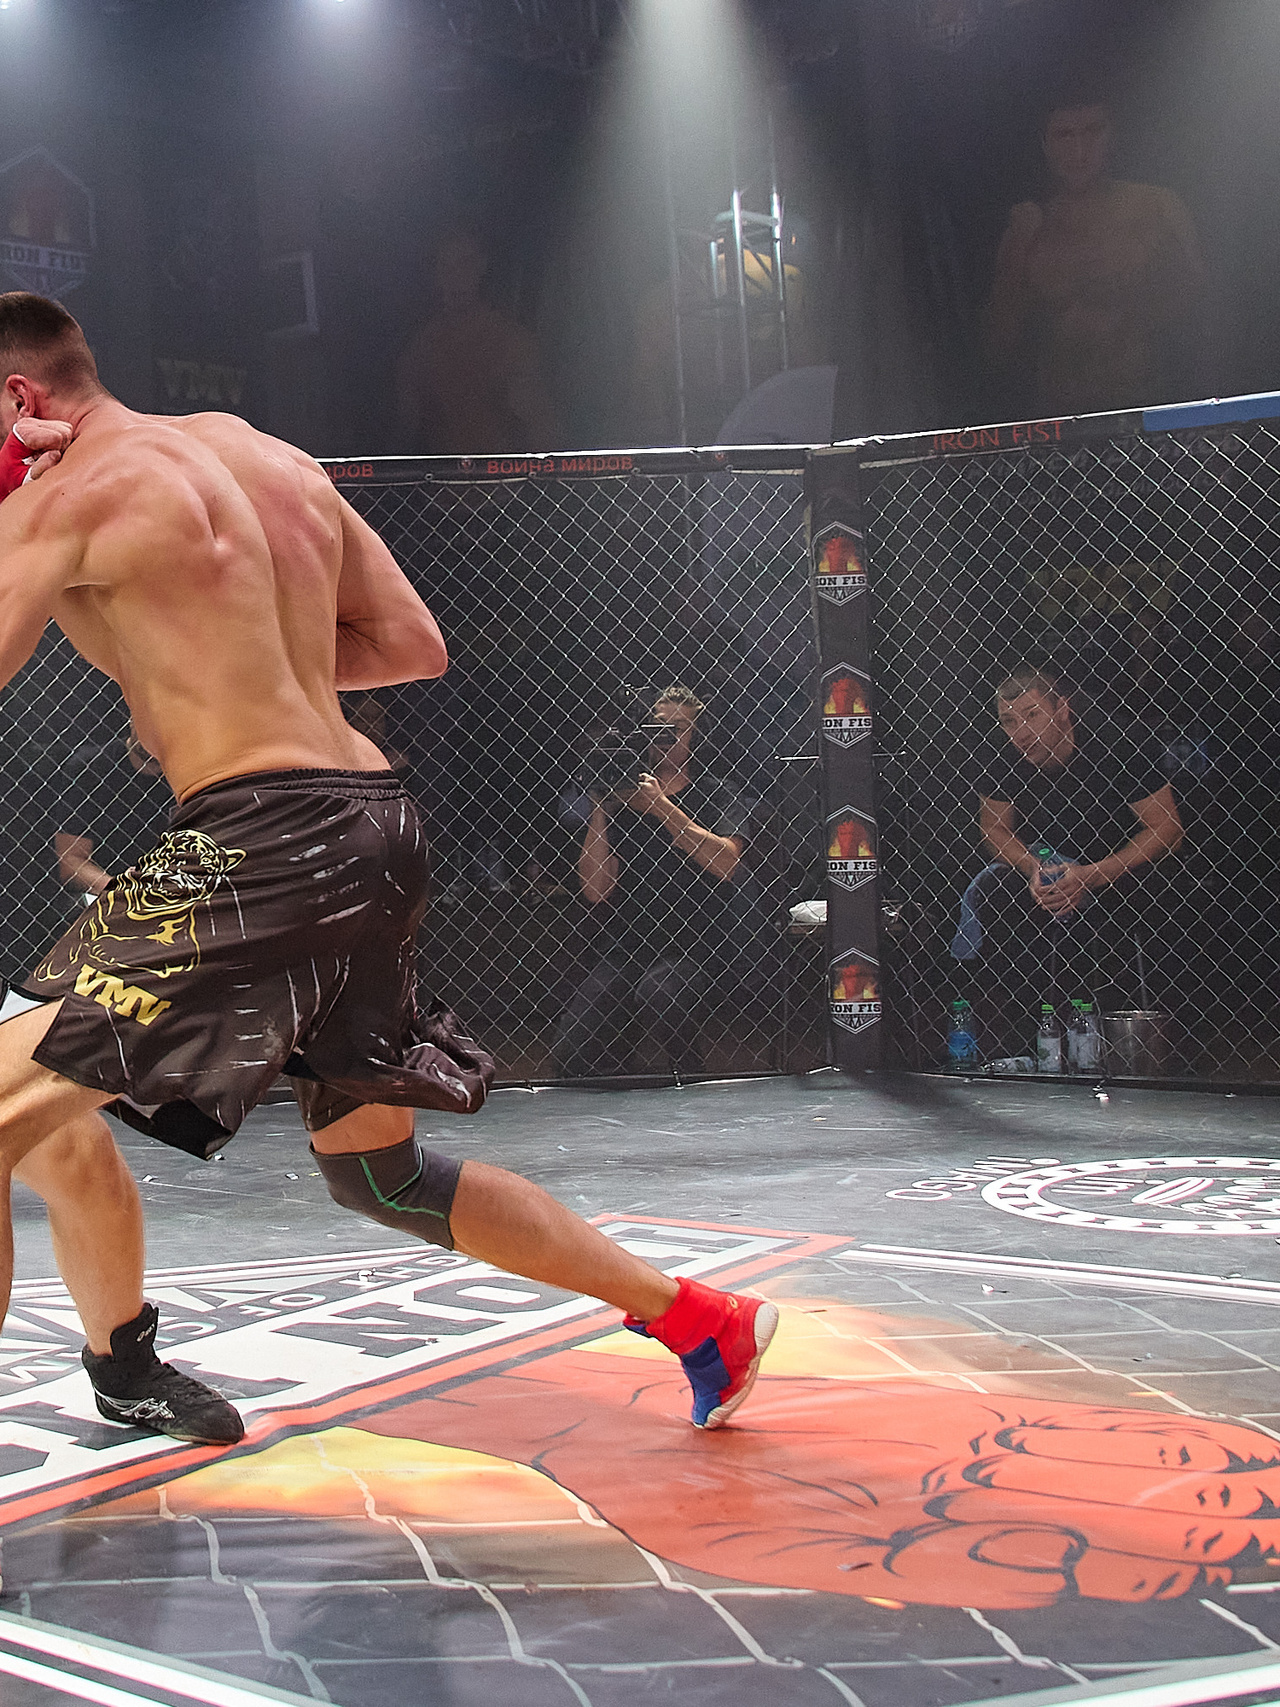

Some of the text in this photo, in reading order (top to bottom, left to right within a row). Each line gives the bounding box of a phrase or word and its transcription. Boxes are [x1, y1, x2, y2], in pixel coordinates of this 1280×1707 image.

[933, 420, 1065, 450] IRON FIST
[74, 963, 172, 1027] VMV
[237, 1293, 327, 1318] OF
